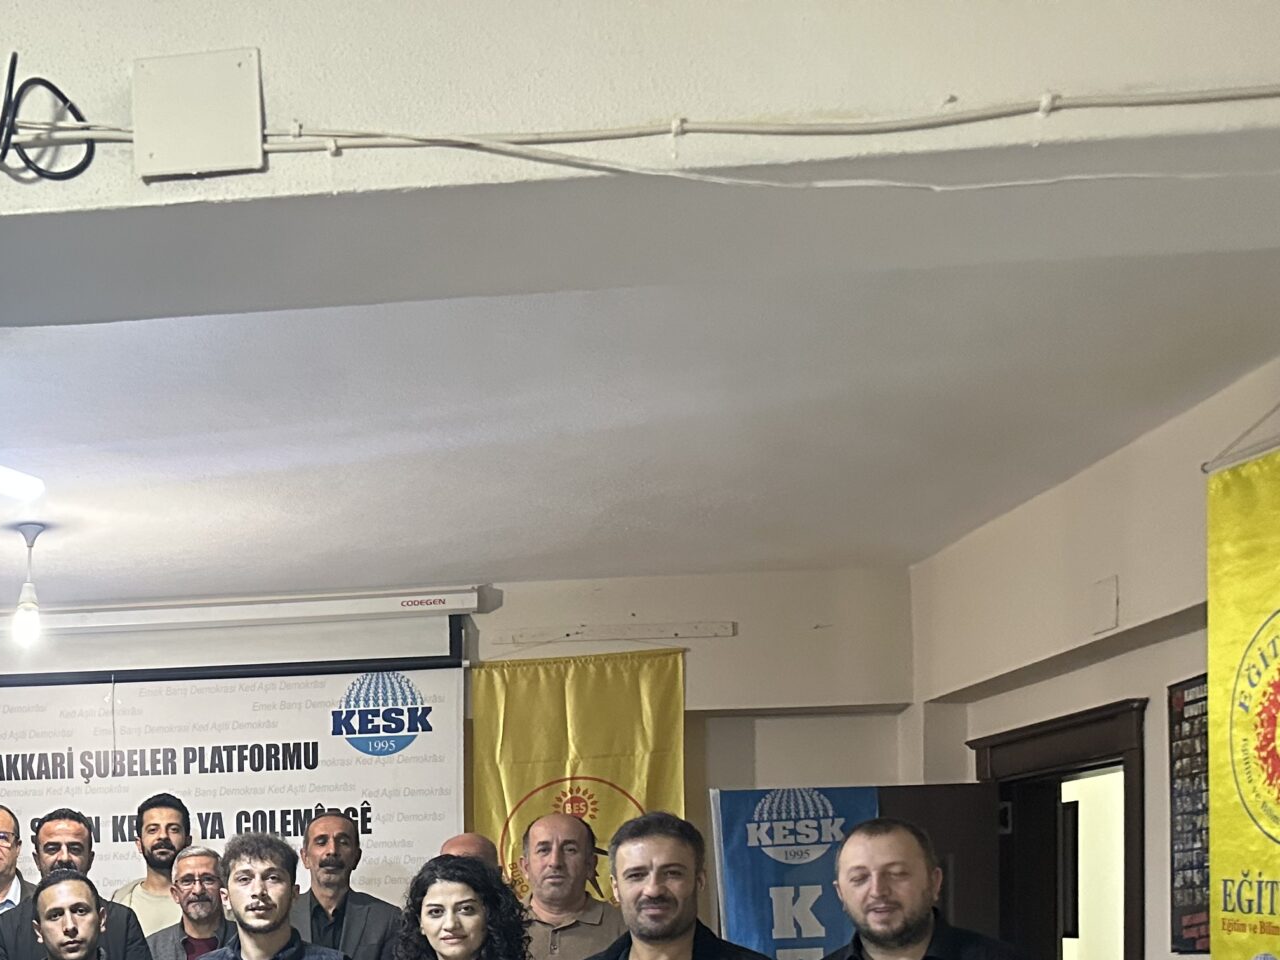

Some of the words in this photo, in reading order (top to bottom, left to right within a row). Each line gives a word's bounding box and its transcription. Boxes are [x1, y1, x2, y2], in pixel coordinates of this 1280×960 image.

[401, 599, 446, 607] CODEGEN
[331, 707, 432, 735] KESK
[368, 740, 396, 751] 1995
[80, 748, 177, 784] ŞUBELER
[183, 742, 318, 775] PLATFORMU
[565, 803, 586, 814] BES
[746, 818, 845, 847] KESK
[784, 849, 810, 861] 1995
[1221, 869, 1280, 915] EĞİT
